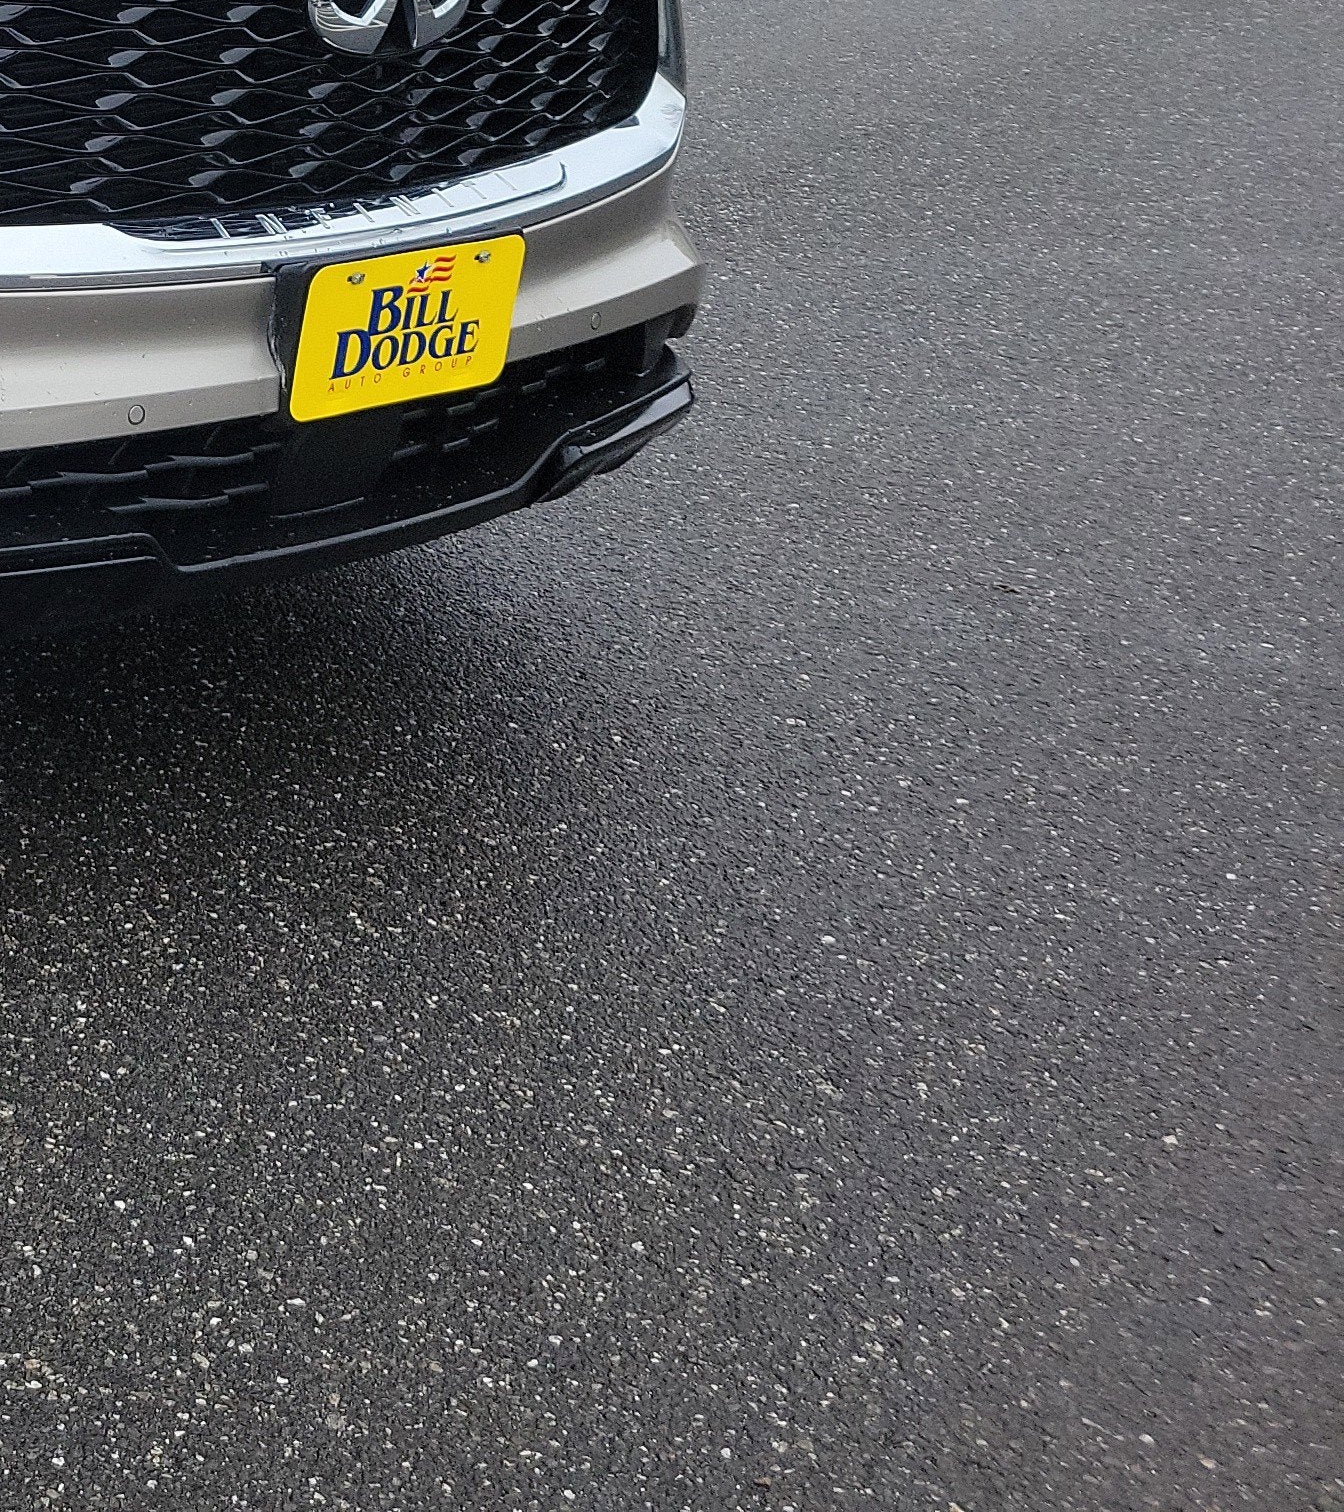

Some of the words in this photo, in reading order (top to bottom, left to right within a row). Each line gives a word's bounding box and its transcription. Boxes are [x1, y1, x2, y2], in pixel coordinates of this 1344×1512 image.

[209, 172, 518, 239] INFINITI
[367, 285, 459, 336] BILL
[327, 373, 382, 393] AUTO
[402, 355, 473, 378] GROUP
[328, 319, 481, 381] DODGE
